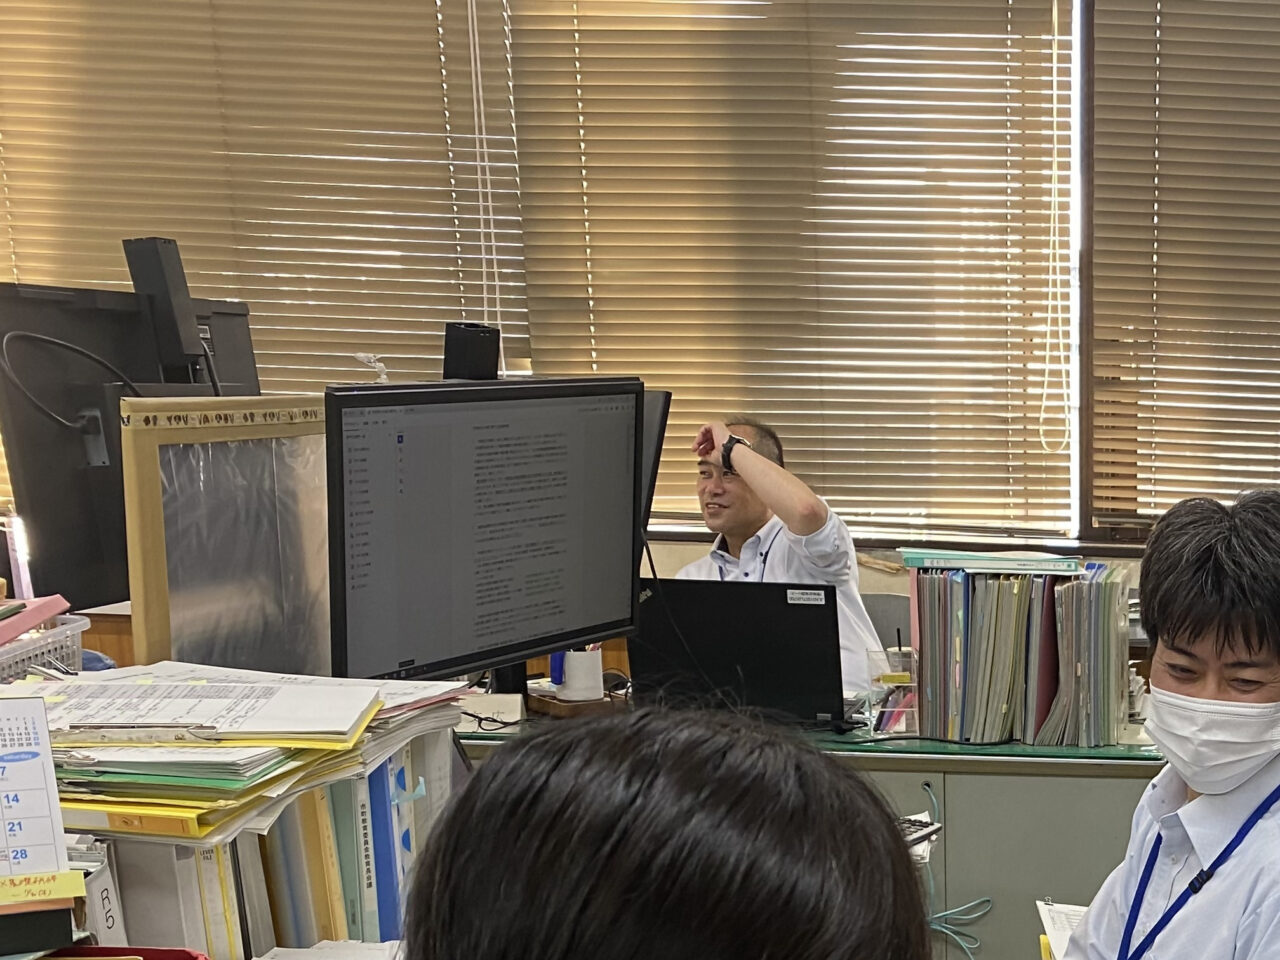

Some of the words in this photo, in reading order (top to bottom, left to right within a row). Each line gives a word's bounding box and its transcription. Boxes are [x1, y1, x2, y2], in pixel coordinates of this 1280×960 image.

[0, 766, 6, 777] 7
[3, 793, 20, 805] 14
[7, 821, 23, 832] 21
[11, 849, 28, 860] 28
